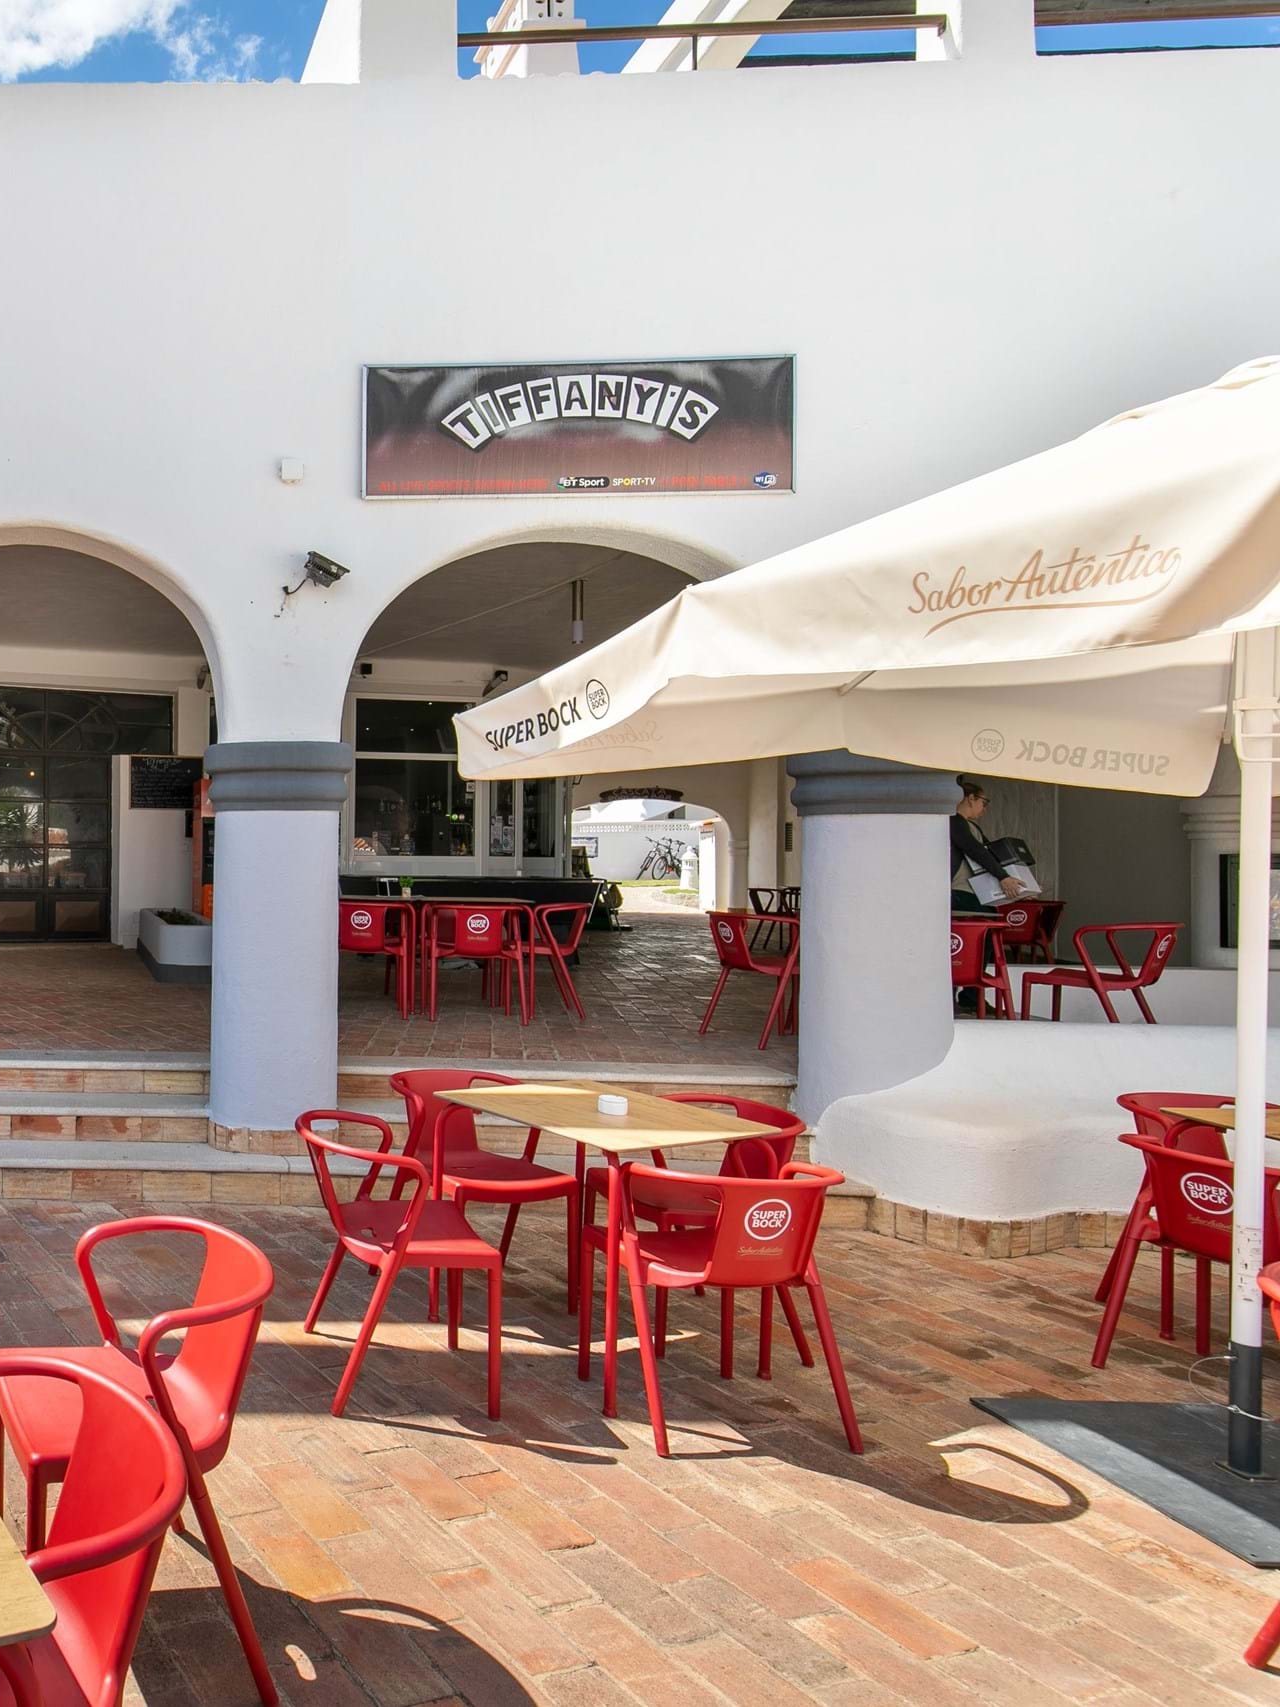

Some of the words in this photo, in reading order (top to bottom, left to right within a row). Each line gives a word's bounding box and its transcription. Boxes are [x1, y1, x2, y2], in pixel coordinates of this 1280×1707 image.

[446, 379, 710, 441] TIFFANY'S
[578, 478, 605, 488] Sport
[907, 565, 1002, 614] Sabor
[1000, 534, 1182, 603] Autêntico
[588, 688, 606, 702] SUPER
[591, 697, 608, 710] BOCK
[485, 717, 535, 752] SUPER
[536, 696, 582, 737] BOCK
[1186, 1180, 1229, 1198] SUPER
[1190, 1189, 1228, 1206] BOCK
[751, 1210, 787, 1220] SUPER
[751, 1218, 784, 1228] BOCK
